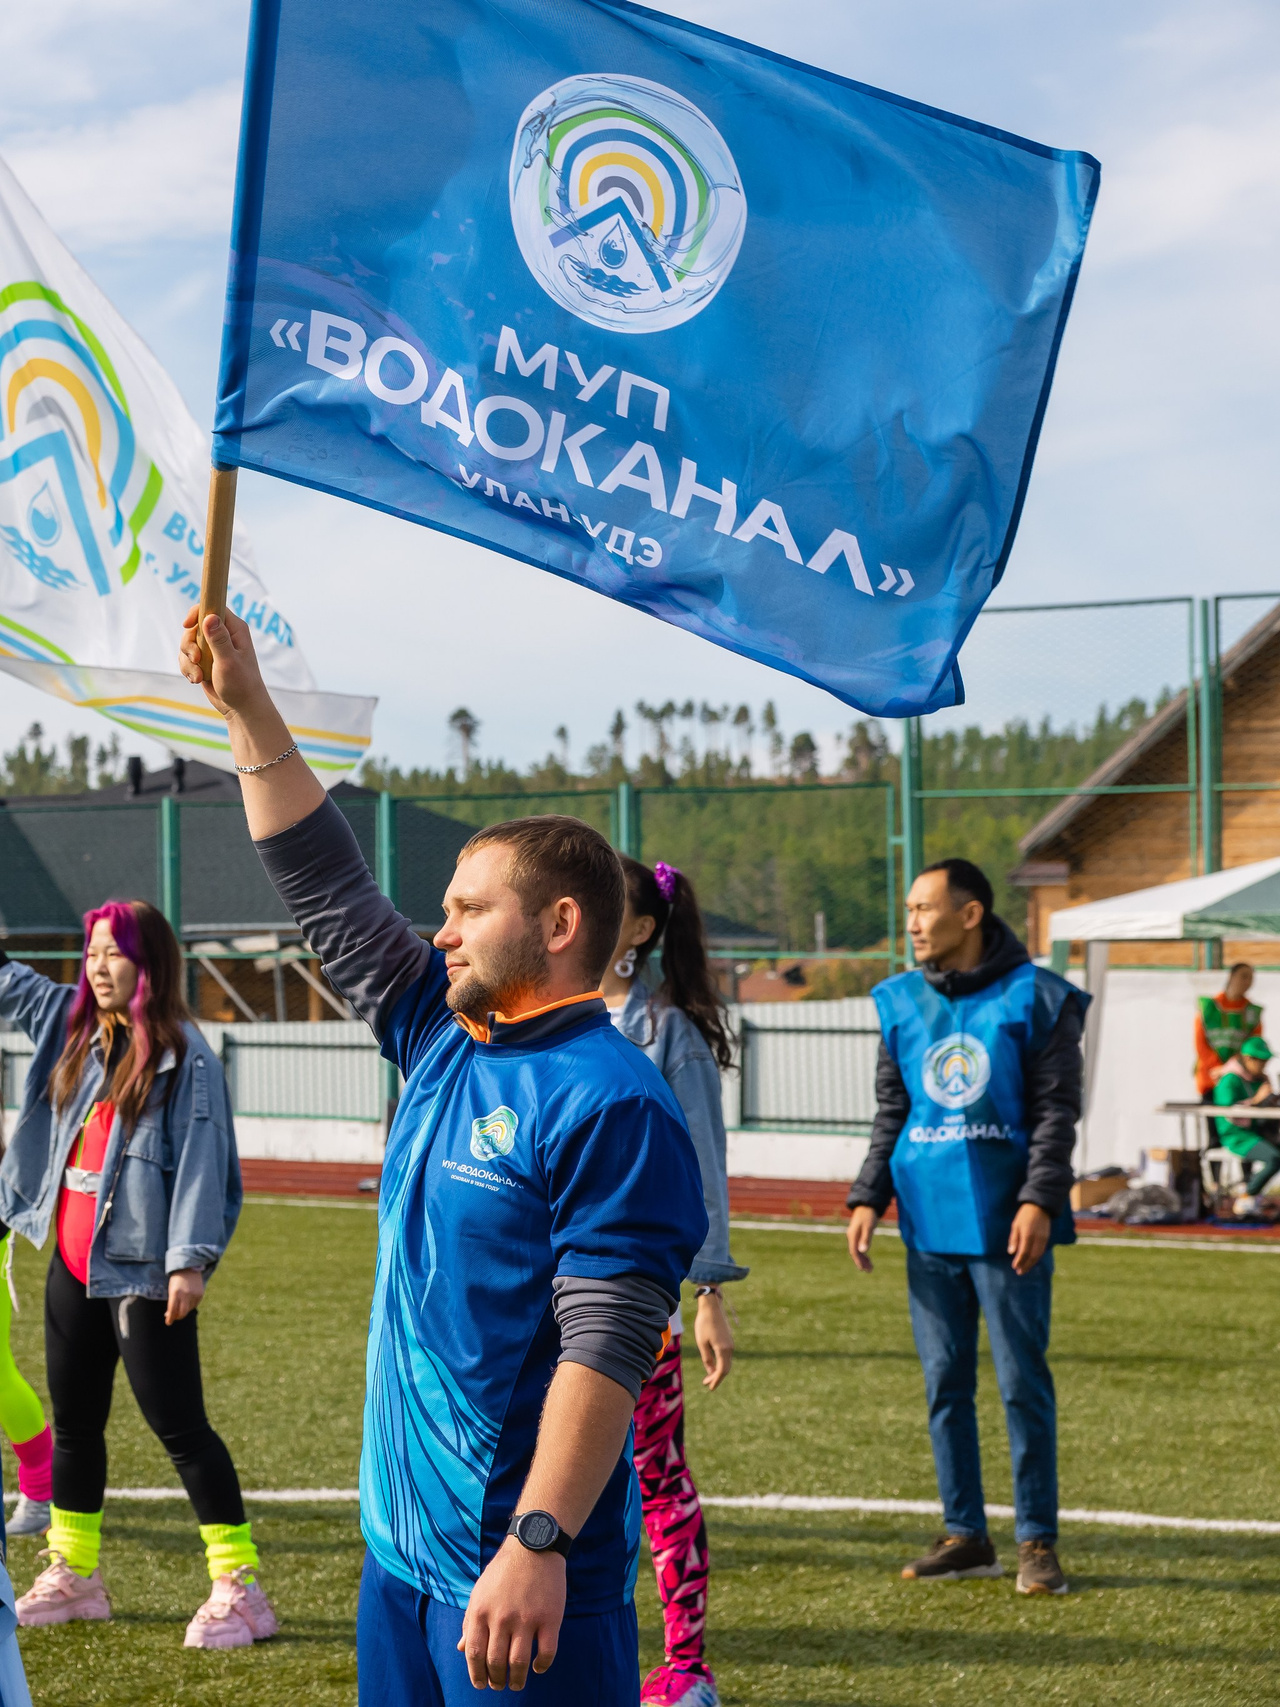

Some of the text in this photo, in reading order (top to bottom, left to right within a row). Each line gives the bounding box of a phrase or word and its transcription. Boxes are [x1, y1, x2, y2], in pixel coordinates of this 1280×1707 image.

[494, 325, 671, 432] МУП
[269, 309, 916, 597] «ВОДОКАНАЛ»
[458, 463, 663, 568] УЛАН-УДЭ
